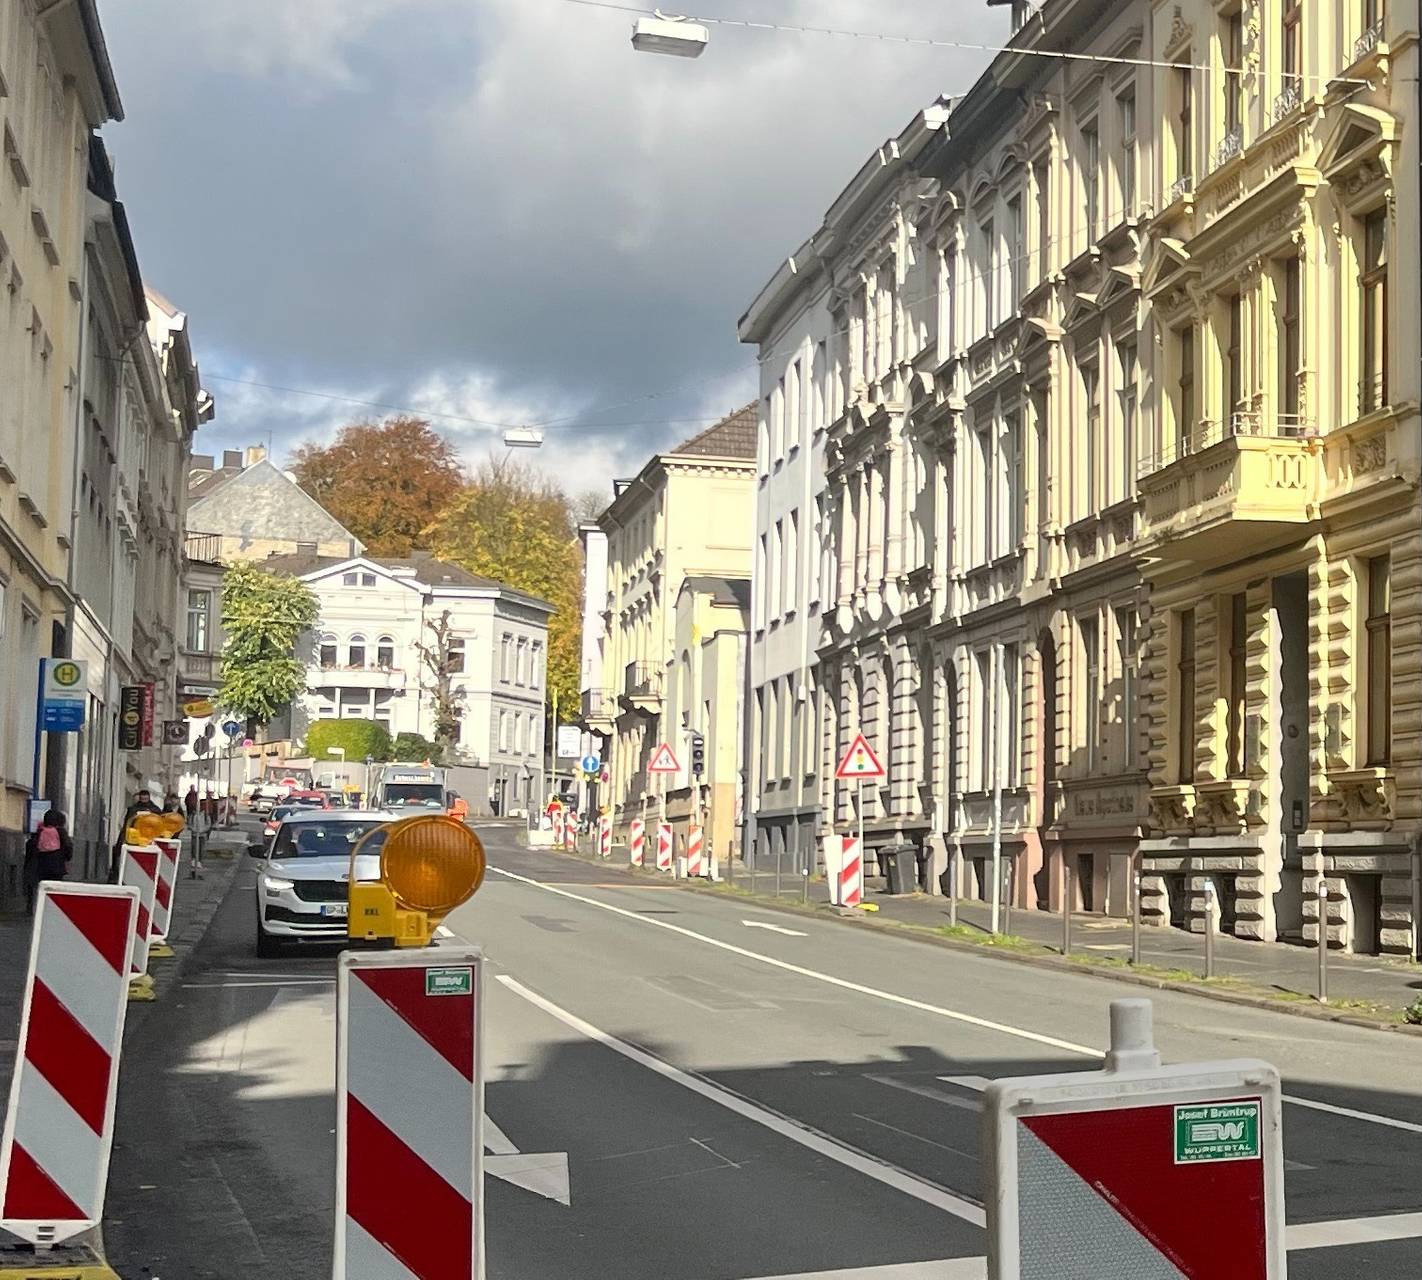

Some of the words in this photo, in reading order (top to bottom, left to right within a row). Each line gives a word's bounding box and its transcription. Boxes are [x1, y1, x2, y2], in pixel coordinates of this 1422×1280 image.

[62, 667, 74, 681] H
[127, 689, 139, 712] You
[1184, 1144, 1252, 1155] WUPPERTAL
